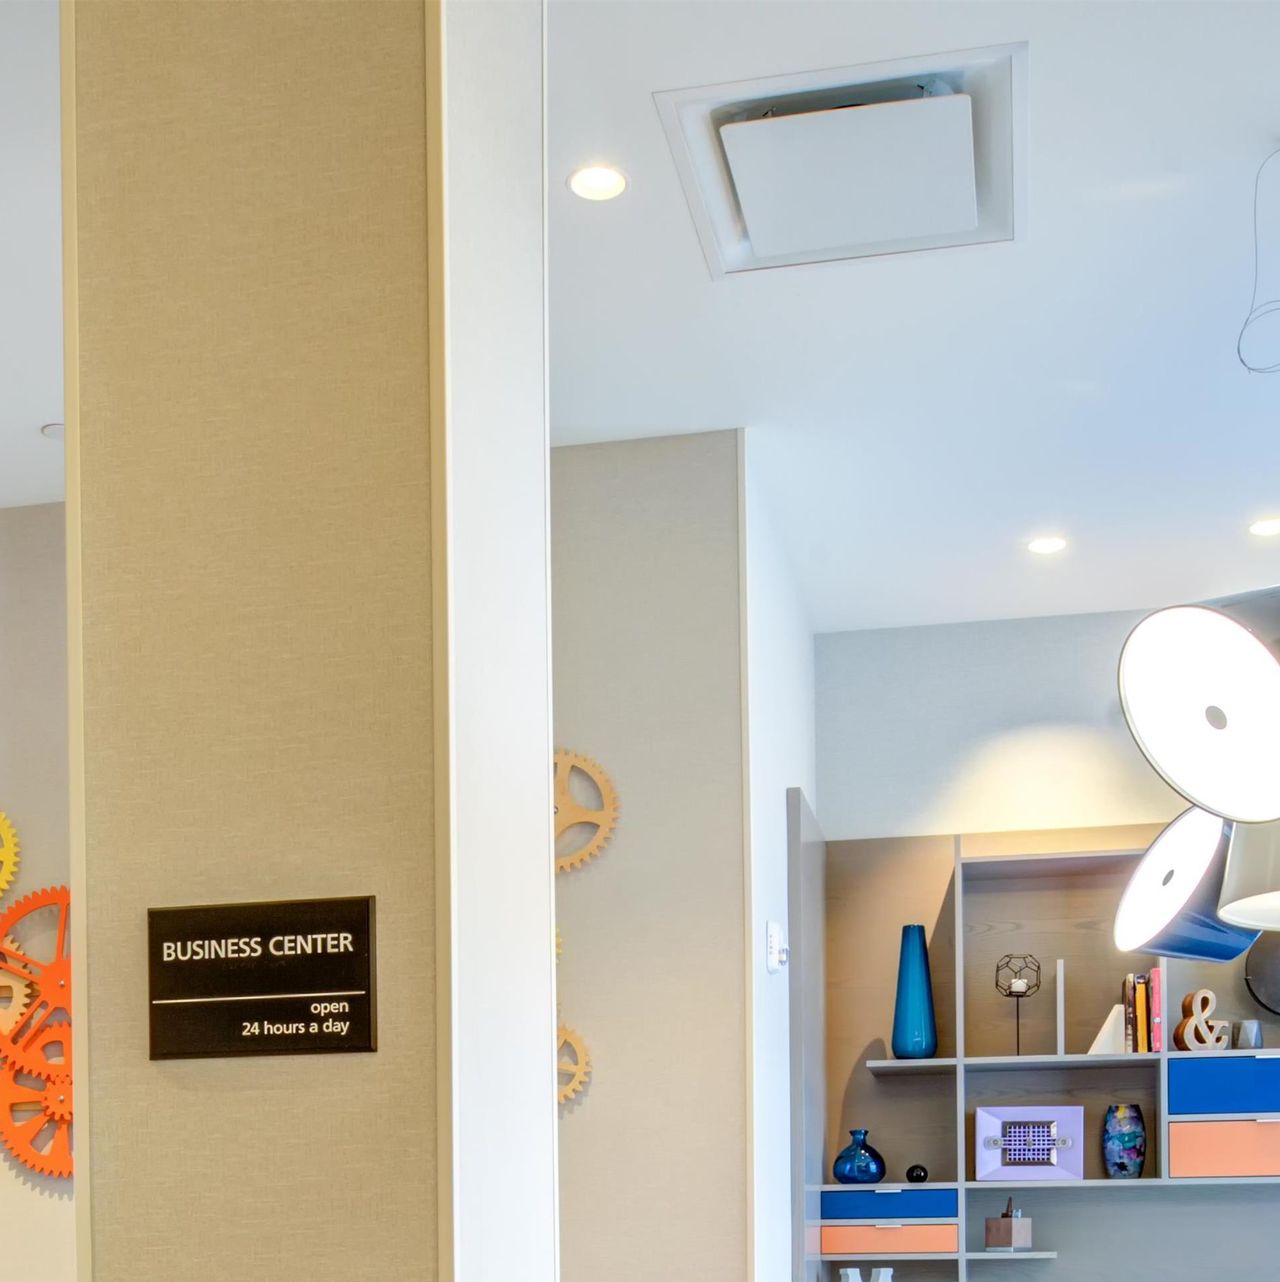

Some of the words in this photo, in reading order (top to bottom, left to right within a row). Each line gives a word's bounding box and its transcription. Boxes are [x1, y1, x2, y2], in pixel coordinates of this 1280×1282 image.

[163, 937, 262, 961] BUSINESS
[268, 932, 354, 956] CENTER
[310, 1002, 349, 1017] open
[1176, 989, 1229, 1051] &
[242, 1022, 260, 1036] 24
[263, 1020, 305, 1035] hours
[309, 1022, 319, 1033] a
[322, 1018, 350, 1035] day
